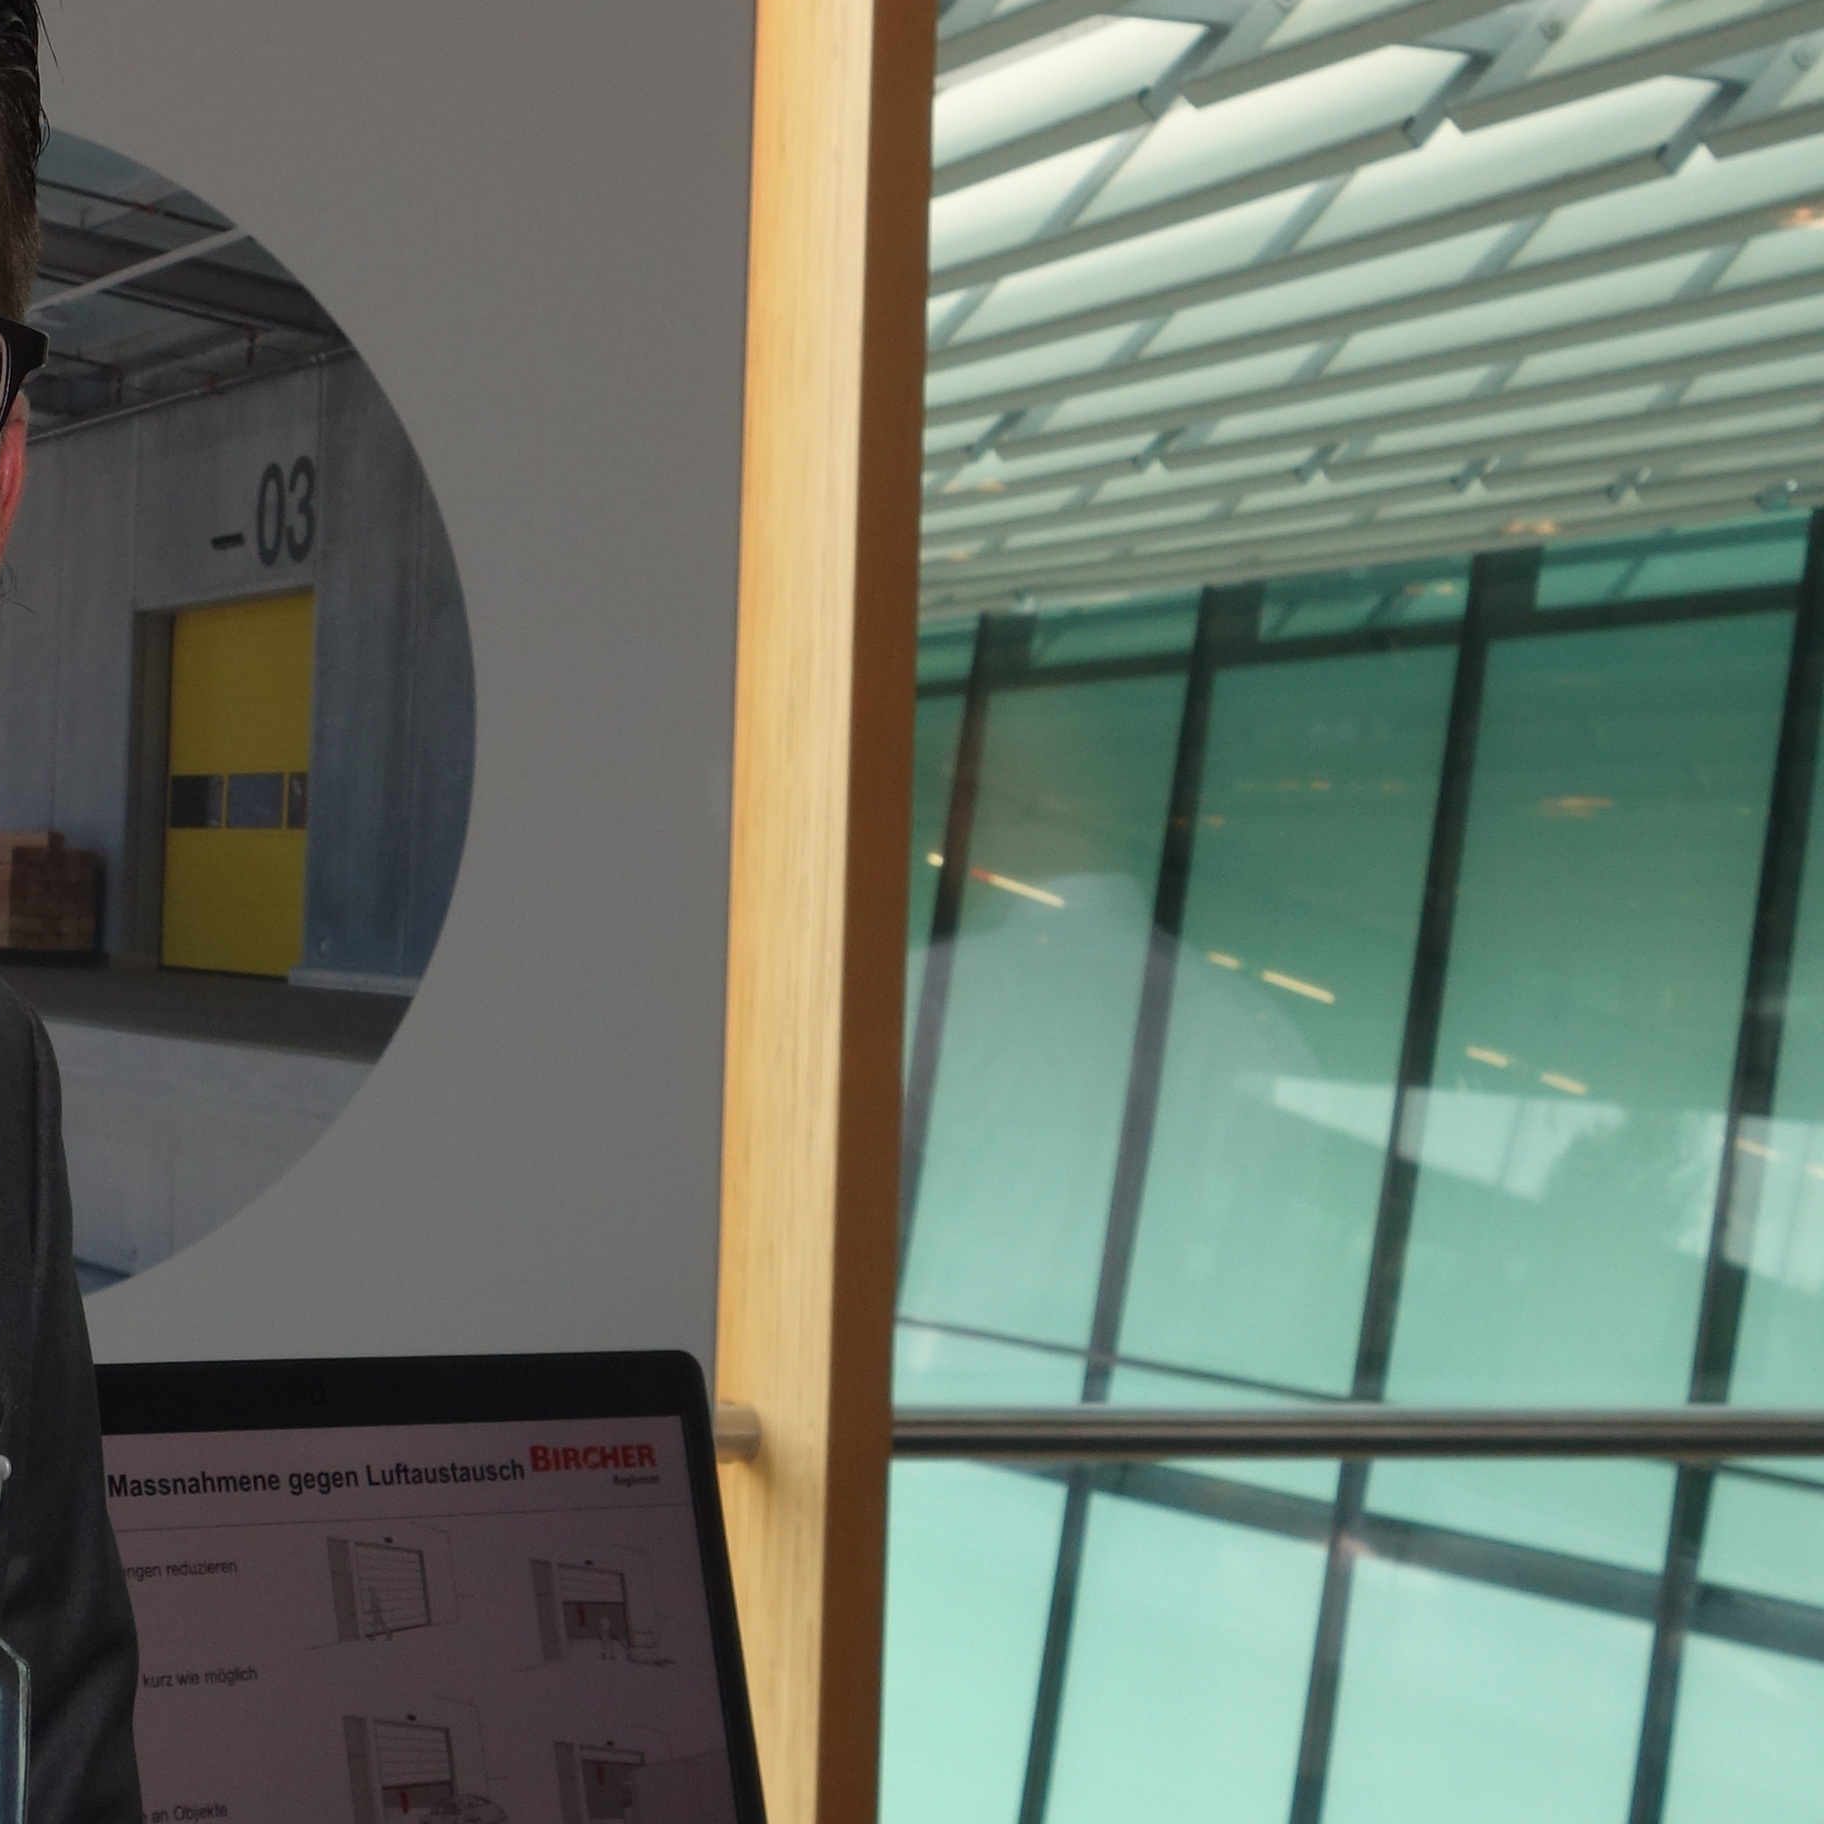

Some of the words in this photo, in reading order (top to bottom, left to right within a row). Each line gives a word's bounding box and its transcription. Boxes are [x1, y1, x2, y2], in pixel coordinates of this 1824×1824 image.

[529, 1443, 657, 1472] BIRCHER
[108, 1472, 280, 1498] Massnahmene
[289, 1470, 359, 1496] gegen
[367, 1460, 526, 1486] Luftaustausch
[166, 1560, 238, 1576] reduzieren
[142, 1673, 174, 1689] kurz
[176, 1671, 200, 1685] wie
[204, 1666, 258, 1687] möglich
[151, 1809, 169, 1823] an
[173, 1803, 228, 1822] Objekte
